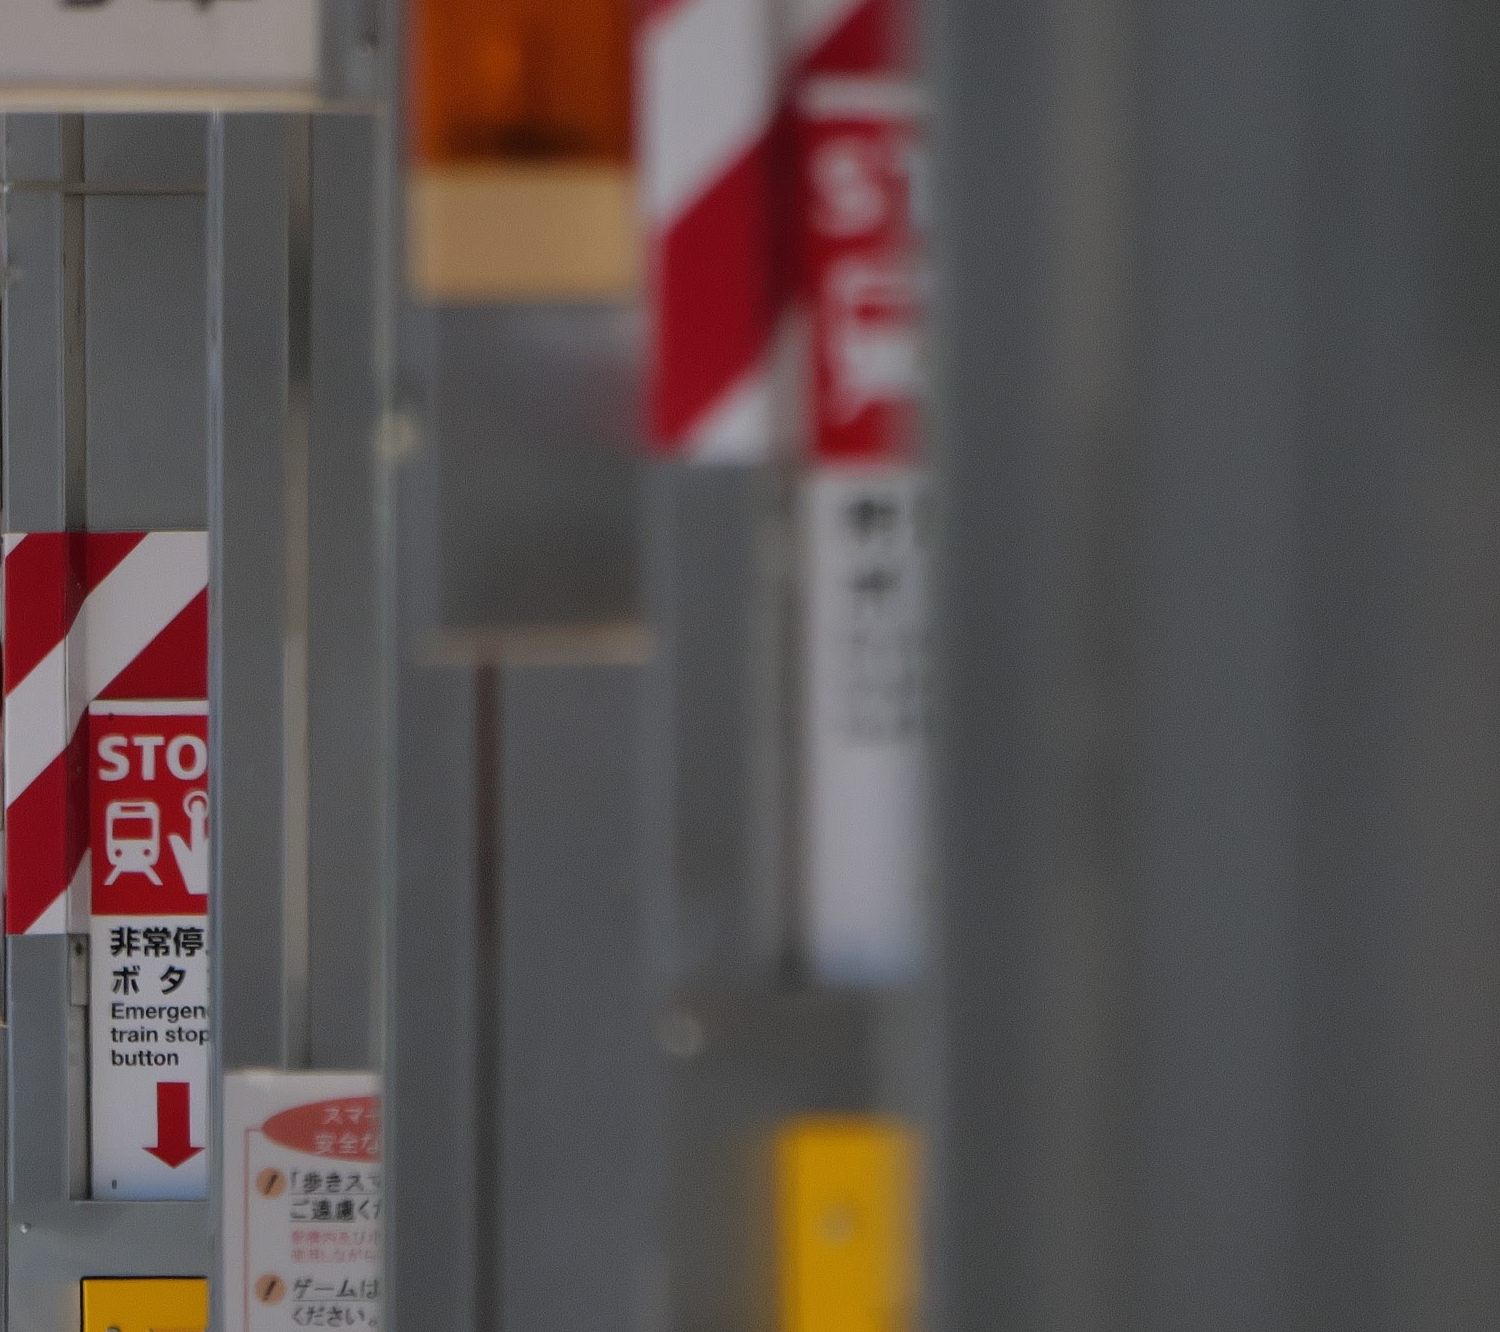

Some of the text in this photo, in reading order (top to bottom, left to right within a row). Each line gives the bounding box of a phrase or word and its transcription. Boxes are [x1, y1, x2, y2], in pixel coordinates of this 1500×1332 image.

[110, 926, 209, 958] 非常停
[110, 1002, 210, 1024] Emergen
[110, 1026, 210, 1046] train stop
[111, 1049, 180, 1067] button
